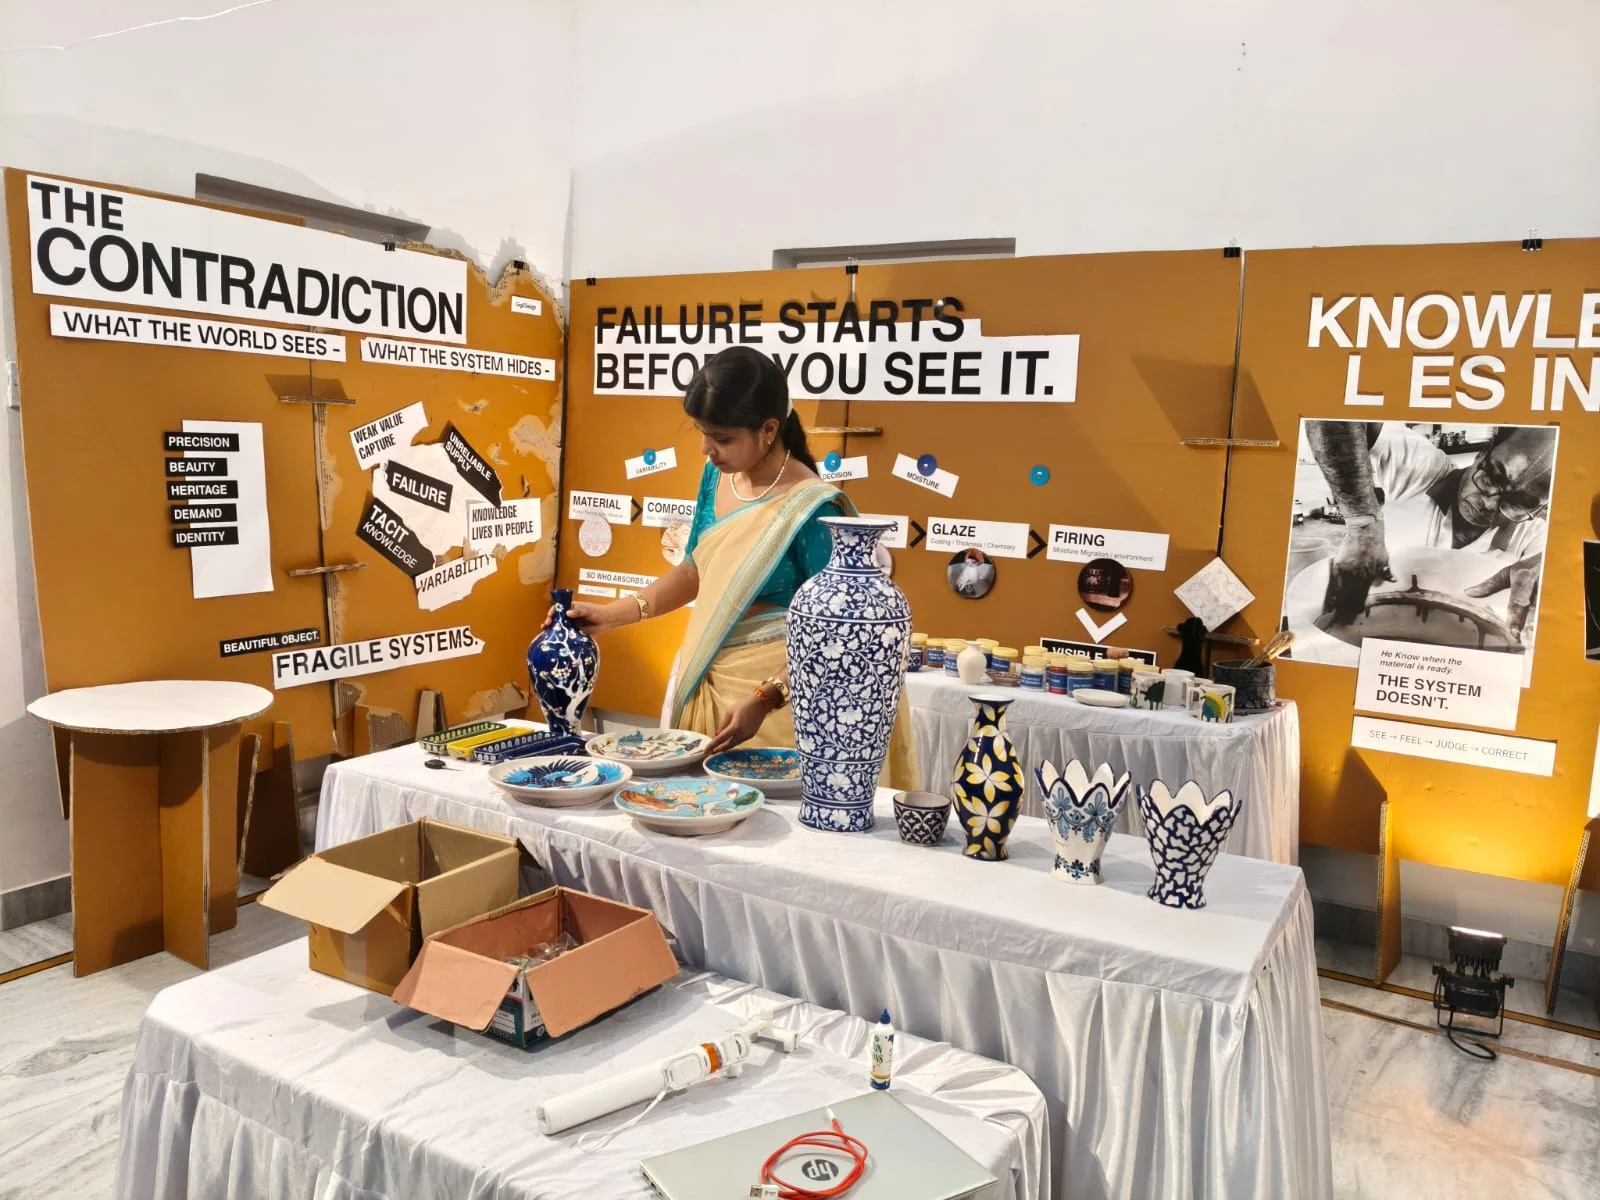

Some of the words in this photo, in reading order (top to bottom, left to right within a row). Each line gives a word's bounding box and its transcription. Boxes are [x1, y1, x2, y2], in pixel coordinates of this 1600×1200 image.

[31, 181, 124, 231] THE
[37, 227, 463, 335] CONTRADICTION
[597, 301, 763, 344] FAILURE
[778, 297, 965, 344] STARTS
[1307, 292, 1600, 350] KNOWLE
[63, 312, 141, 338] WHAT
[148, 320, 191, 342] THE
[198, 324, 276, 350] WORLD
[283, 334, 327, 356] SEES
[368, 341, 415, 362] WHAT
[420, 348, 447, 366] THE
[450, 352, 503, 372] SYSTEM
[507, 359, 542, 376] HIDES
[597, 352, 712, 392] BEFO
[772, 352, 867, 395] YOU
[883, 351, 982, 395] SEE
[1001, 350, 1054, 395] IT.
[1530, 356, 1600, 411] IN
[353, 425, 378, 444] WEAK
[379, 412, 404, 431] VALUE
[168, 436, 230, 448] PRECISION
[358, 433, 396, 460] CAPTURE
[169, 461, 216, 473] BEAUTY
[445, 441, 472, 472] SUPPLY
[449, 431, 493, 481] UNRELIABLE
[822, 471, 853, 480] DECISION
[906, 471, 940, 490] MOISTURE
[171, 484, 228, 496] HERITAGE
[392, 472, 447, 506] FAILURE
[174, 508, 222, 520] DEMAND
[472, 504, 518, 523] KNOWLEDGE
[573, 495, 621, 510] MATERIAL
[368, 505, 409, 543] TACIT
[472, 525, 493, 541] LIVES
[494, 525, 504, 537] IN
[505, 520, 534, 536] PEOPLE
[932, 523, 977, 538] GLAZE
[176, 531, 225, 544] IDENTITY
[363, 522, 418, 569] KNOWLEDGE
[1055, 531, 1105, 547] FIRING
[1080, 549, 1109, 559] Migration
[420, 554, 490, 593] VARIABILITY
[586, 571, 596, 579] SO
[597, 573, 612, 581] WHO
[613, 575, 644, 585] ABSORBS
[223, 635, 279, 653] BEAUTIFUL
[281, 630, 320, 646] OBJECT.
[276, 641, 383, 679] FRAGILE
[388, 627, 479, 660] SYSTEMS.
[1379, 660, 1415, 670] material
[1416, 663, 1425, 671] is
[1427, 665, 1453, 675] ready.
[1381, 650, 1393, 658] He
[1395, 651, 1420, 660] Know
[1422, 654, 1445, 664] when
[1448, 657, 1463, 666] the
[1378, 673, 1409, 689] THE
[1414, 678, 1481, 697] SYSTEM
[1376, 689, 1448, 710] DOESN'T.
[1369, 729, 1387, 740] SEE
[1399, 733, 1422, 745] FEEL
[1435, 739, 1468, 752] JUDGE
[1481, 746, 1528, 761] CORRECT
